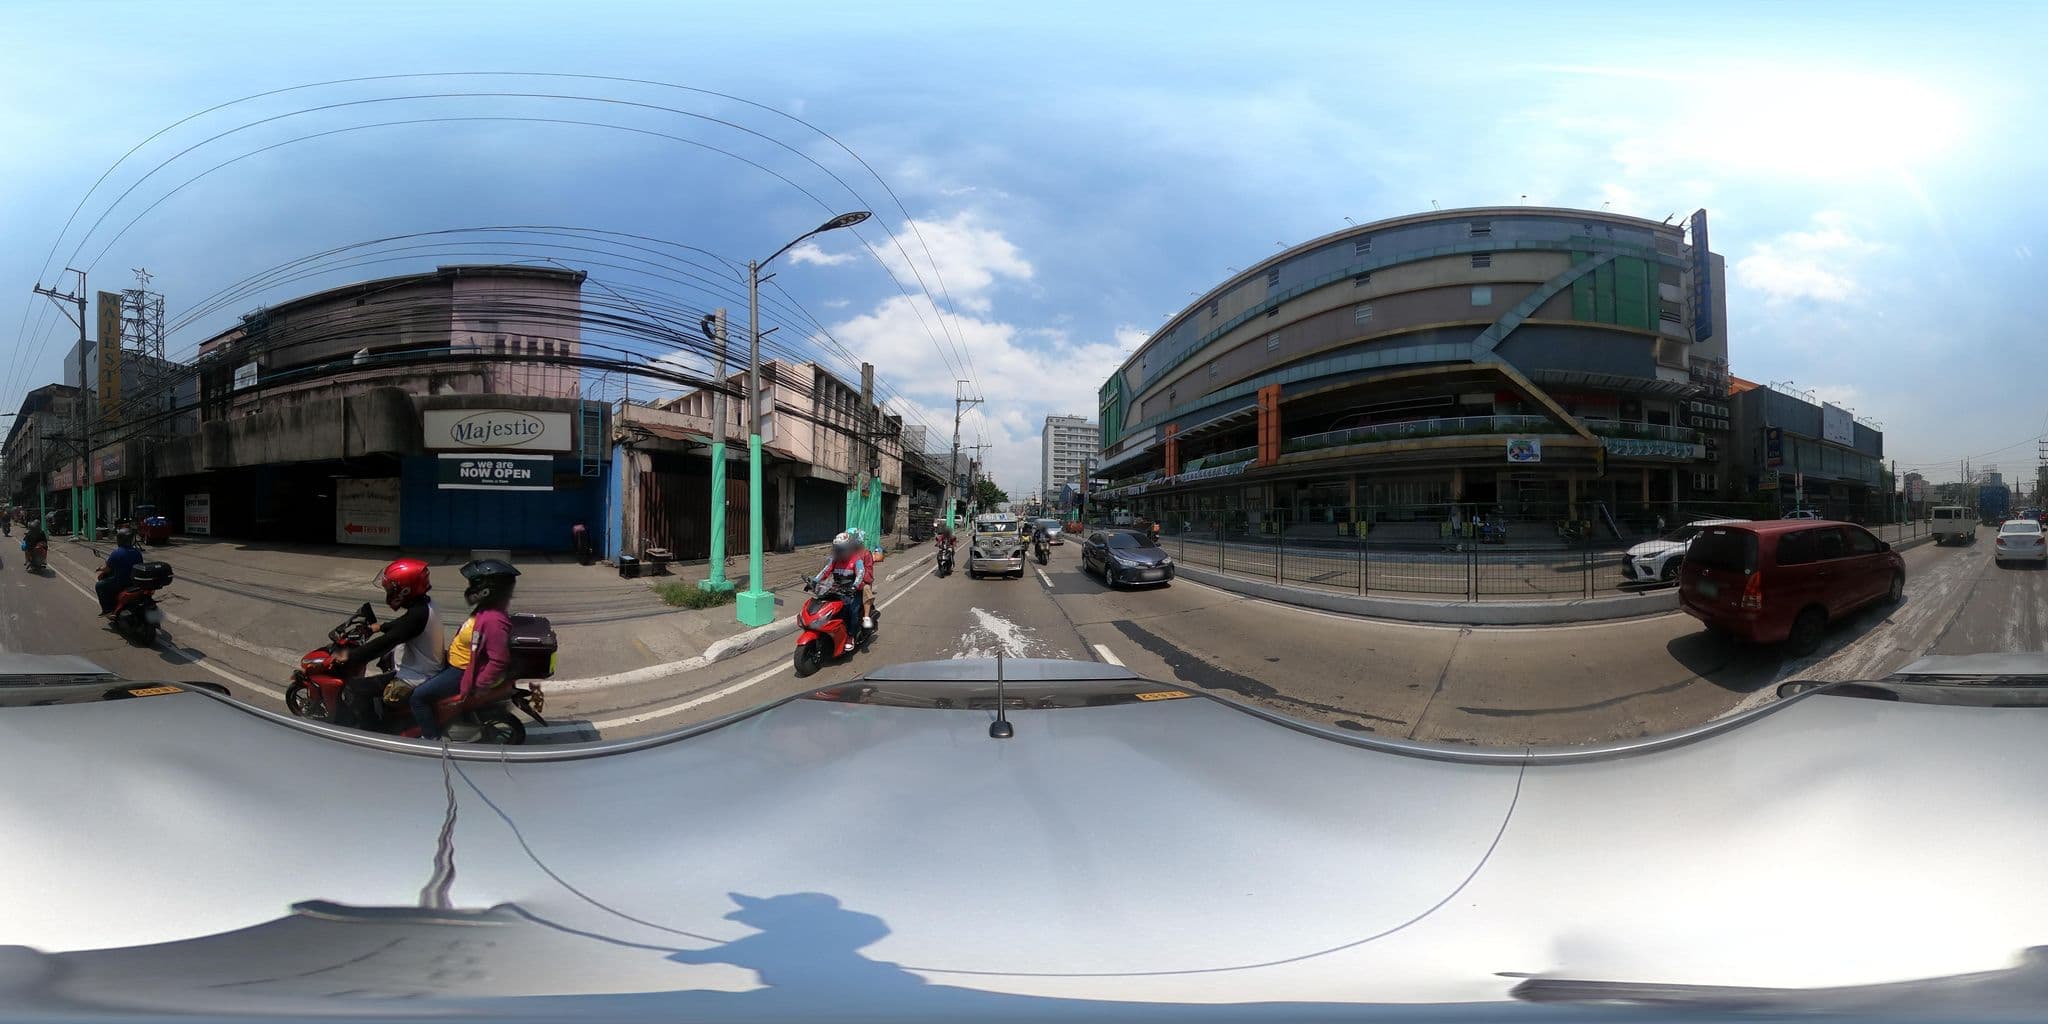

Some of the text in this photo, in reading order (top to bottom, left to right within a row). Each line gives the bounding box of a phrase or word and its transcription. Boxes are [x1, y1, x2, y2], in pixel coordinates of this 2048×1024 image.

[455, 419, 539, 443] Majestic
[477, 461, 494, 469] we
[496, 461, 514, 469] are
[460, 468, 531, 479] NOW OPEN
